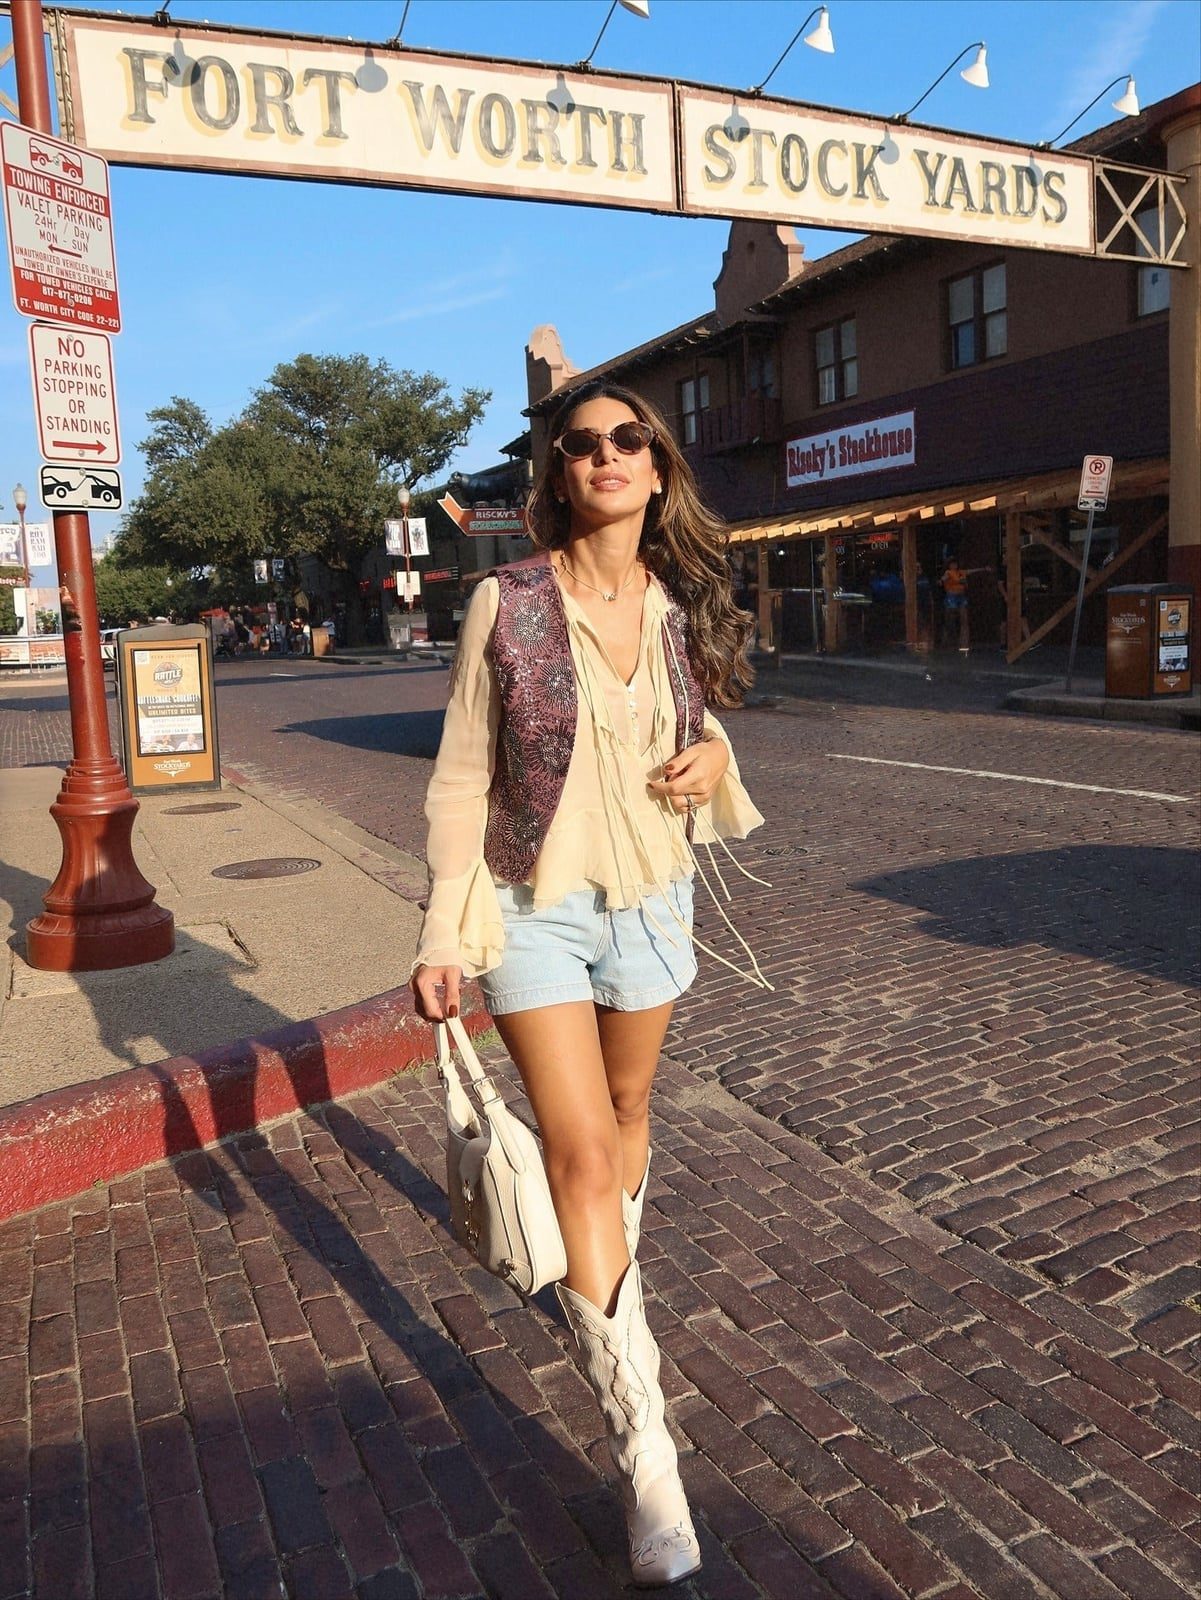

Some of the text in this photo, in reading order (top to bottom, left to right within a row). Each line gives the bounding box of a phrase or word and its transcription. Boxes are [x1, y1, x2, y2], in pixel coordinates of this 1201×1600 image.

[121, 47, 1067, 224] FORT WORTH STOCK YARDS
[9, 167, 105, 213] TOWING ENFORCED
[16, 191, 103, 232] VALET PARKING
[34, 213, 57, 231] 24Hr
[74, 226, 90, 241] Day
[39, 228, 58, 244] MON
[72, 238, 89, 253] SUN
[15, 246, 113, 280] UNAUTHORIZED VEHICLES WILL BE
[23, 258, 108, 289] TOWED AT OWNER'S EXPENSE
[20, 269, 34, 282] FOR
[37, 273, 61, 287] TOWED
[62, 278, 93, 296] VEHICLES
[20, 297, 32, 309] FT.
[33, 300, 58, 315] WORTH
[59, 306, 75, 319] CITY
[77, 312, 94, 323] CODE
[57, 336, 85, 358] NO
[44, 358, 102, 379] PARKING
[43, 377, 107, 398] STOPPING
[68, 399, 86, 415] OR
[46, 416, 111, 435] STANDING
[839, 428, 913, 467] Steakhouse
